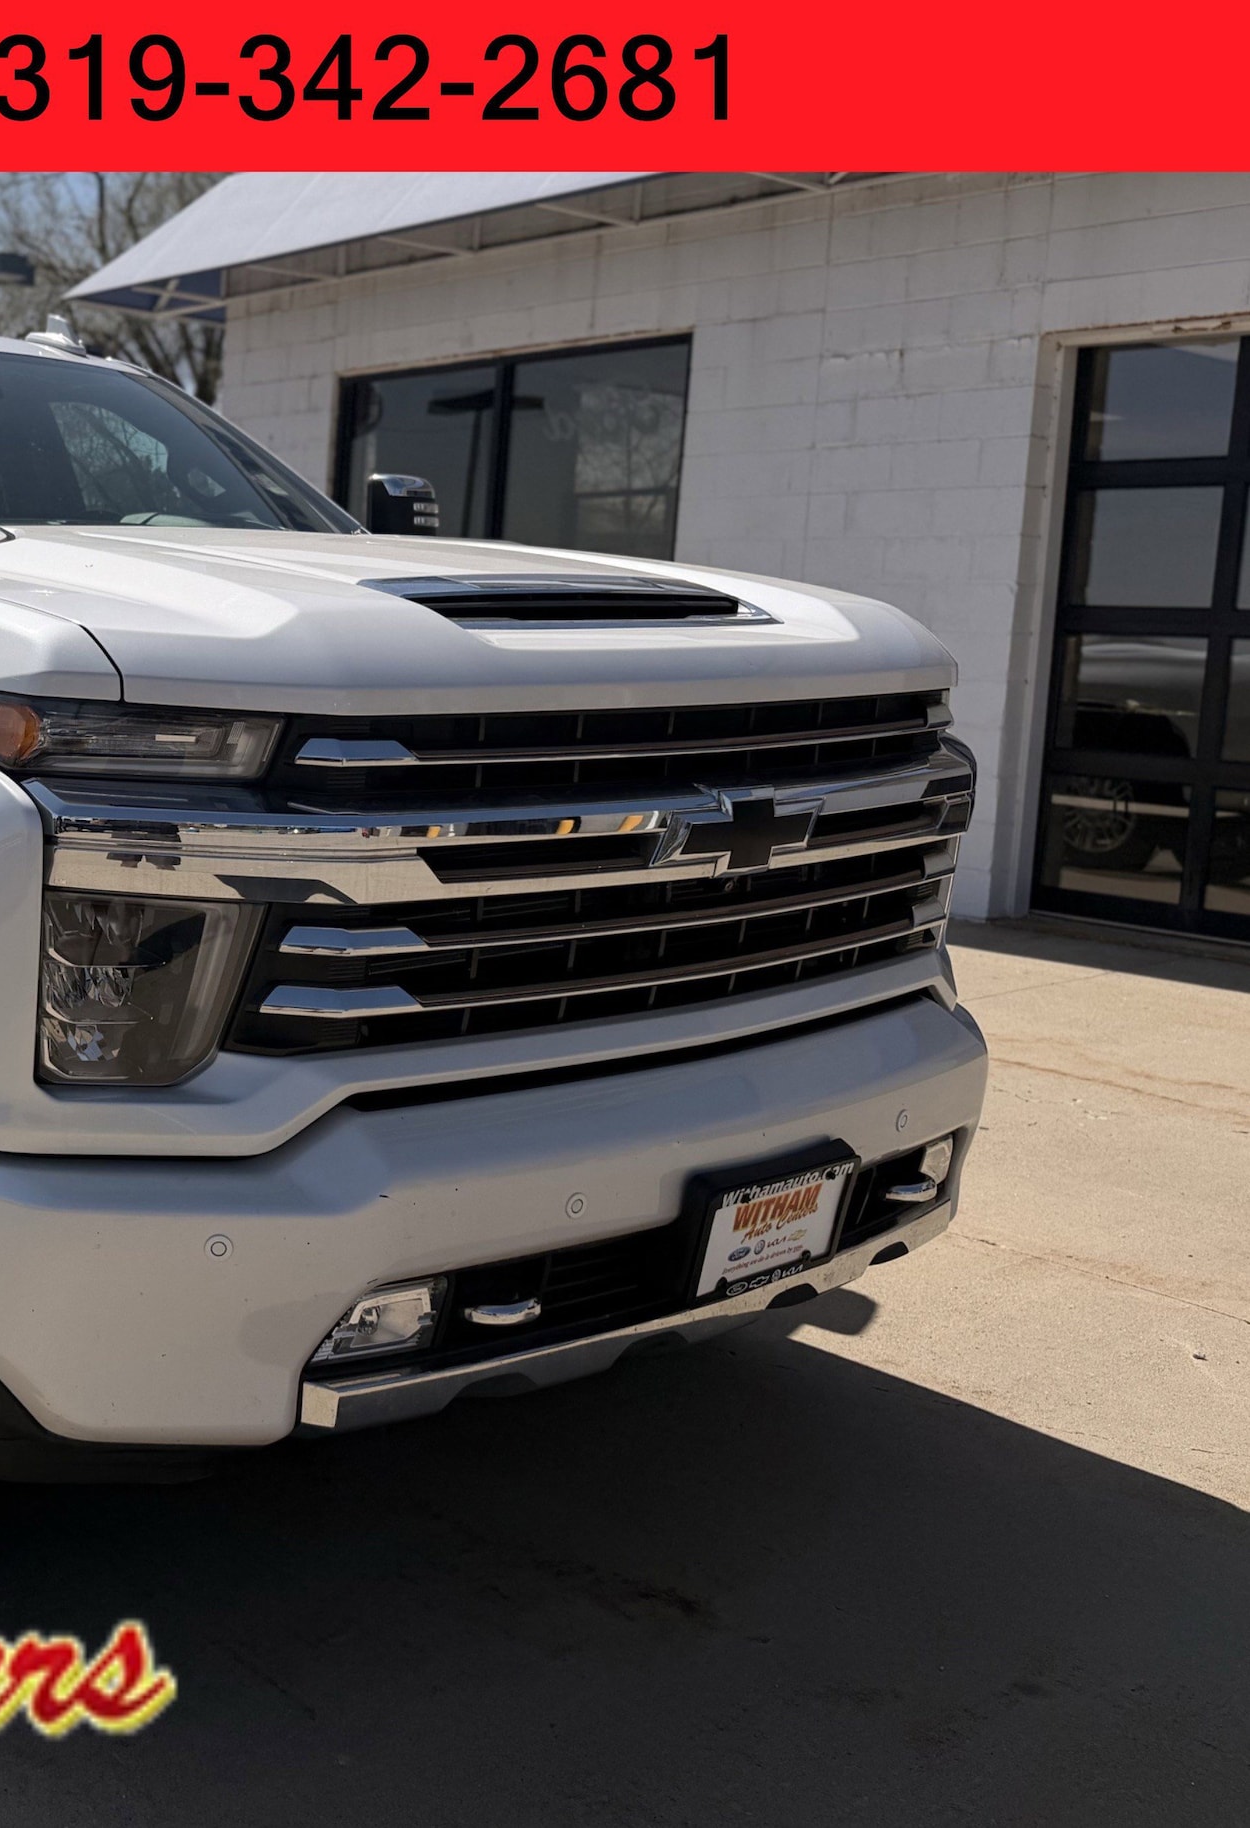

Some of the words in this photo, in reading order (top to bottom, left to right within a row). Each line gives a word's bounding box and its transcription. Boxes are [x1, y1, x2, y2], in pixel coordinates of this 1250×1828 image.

[733, 1183, 823, 1232] WITHAM
[741, 1221, 772, 1244] Auto
[776, 1202, 818, 1230] Centers
